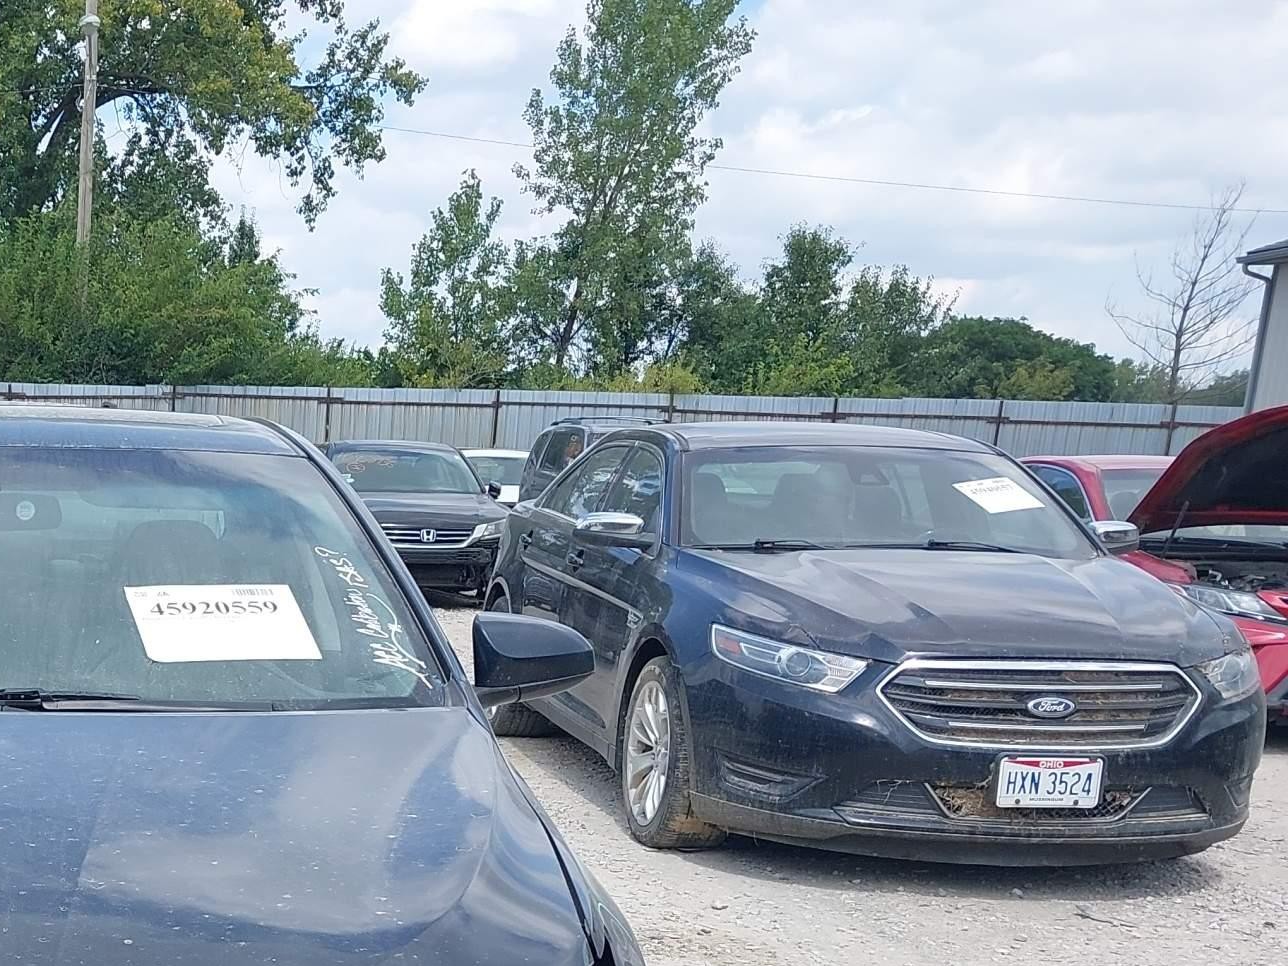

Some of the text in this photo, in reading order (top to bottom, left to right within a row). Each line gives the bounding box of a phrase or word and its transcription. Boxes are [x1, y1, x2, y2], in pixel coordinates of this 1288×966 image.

[150, 600, 278, 616] 45920559
[1038, 700, 1066, 712] Ford
[1006, 771, 1094, 796] HXN 3524
